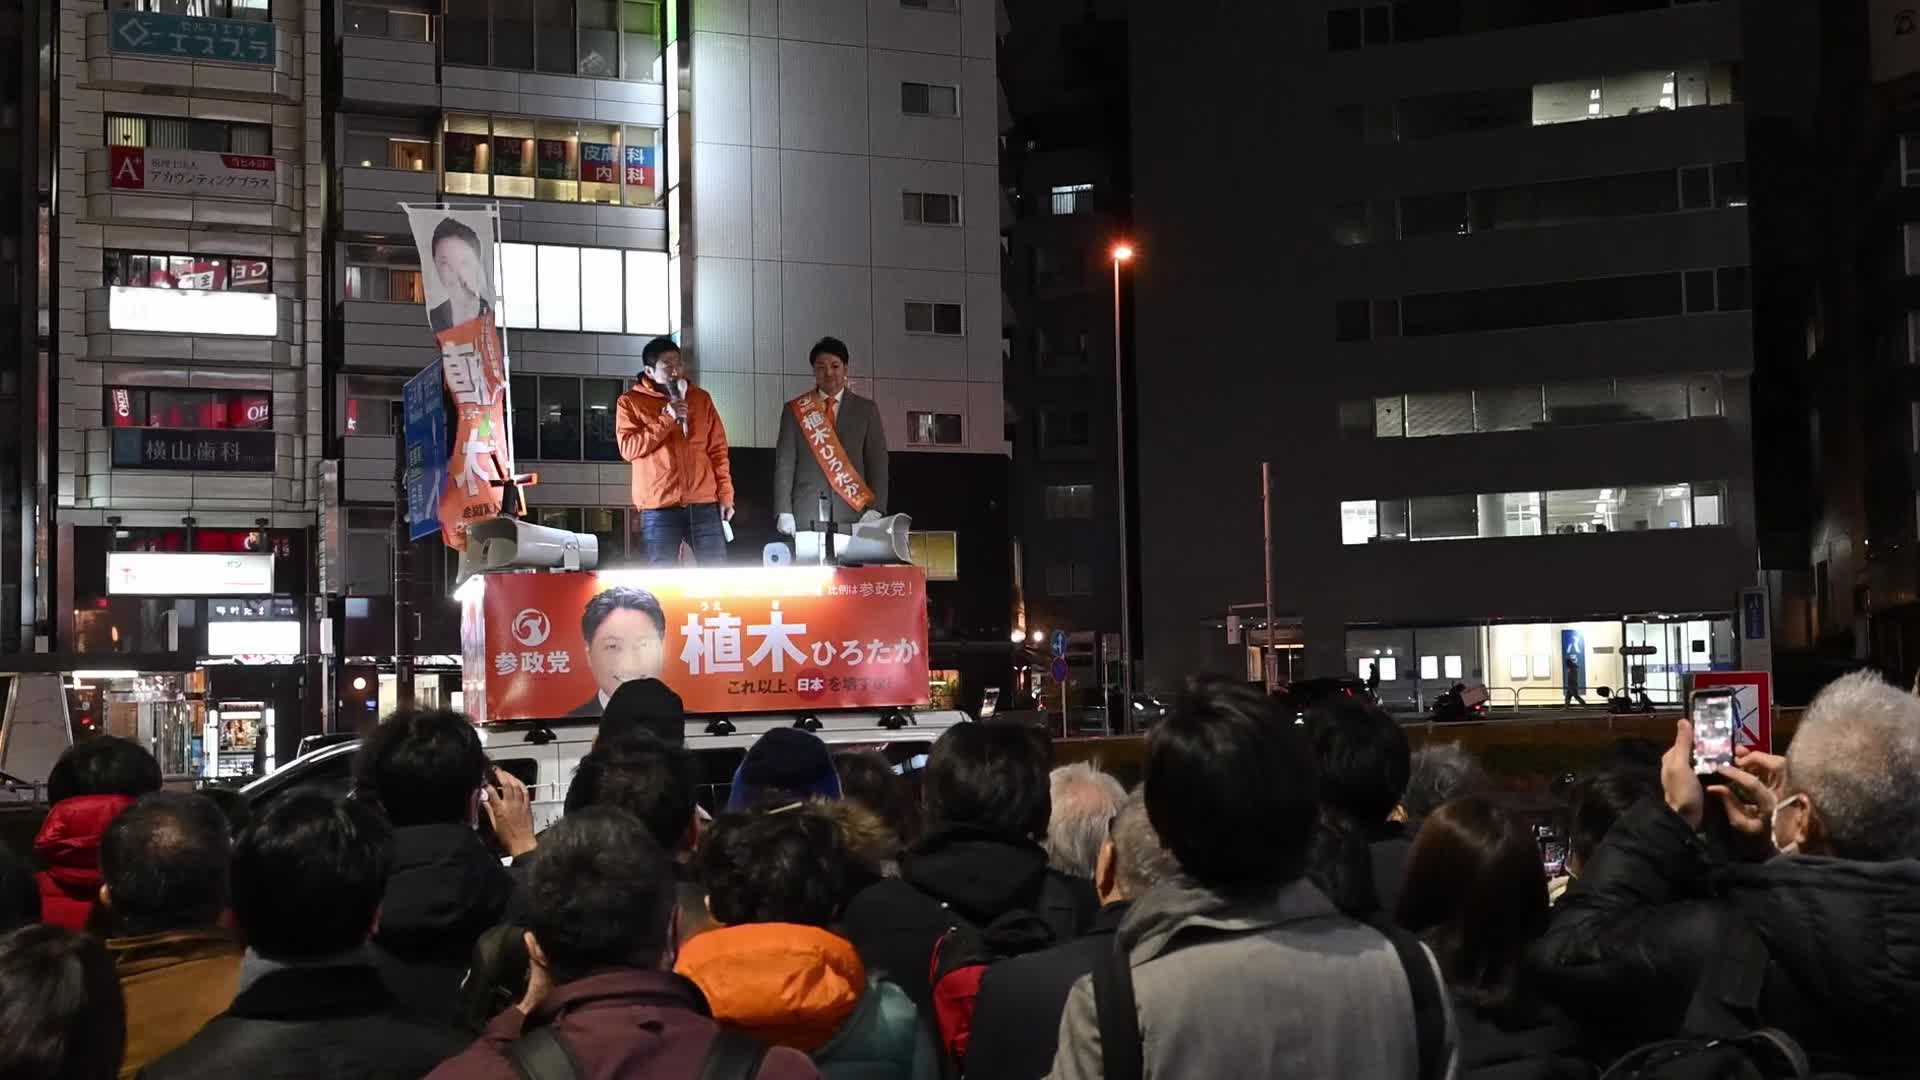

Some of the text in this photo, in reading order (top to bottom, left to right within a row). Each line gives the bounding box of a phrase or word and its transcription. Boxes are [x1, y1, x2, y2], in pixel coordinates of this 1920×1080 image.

[596, 166, 645, 184] 内科
[146, 440, 240, 462] 横山歯科
[801, 410, 860, 498] 植木ひろたか
[495, 652, 571, 674] 参政党
